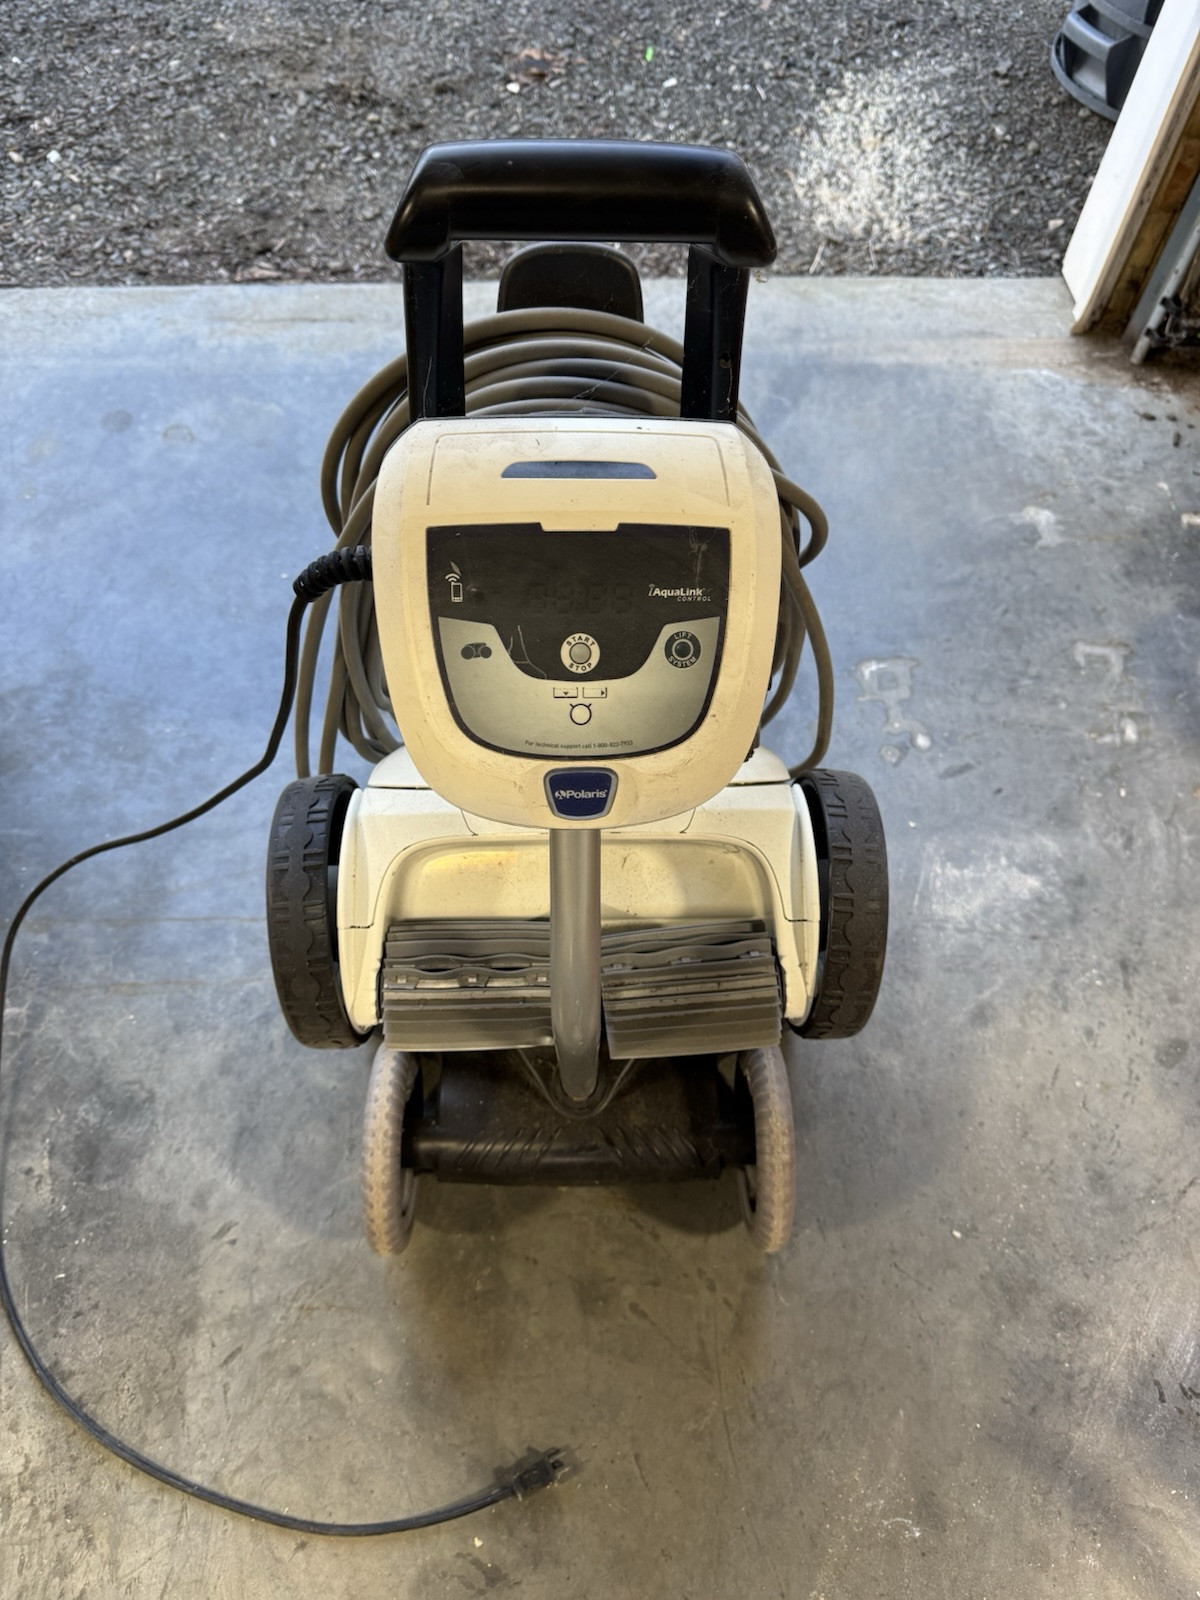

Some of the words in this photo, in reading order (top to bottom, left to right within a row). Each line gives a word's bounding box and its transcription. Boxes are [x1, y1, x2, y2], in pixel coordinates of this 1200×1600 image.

[673, 631, 693, 640] LIFT
[566, 635, 596, 647] START
[668, 655, 697, 668] SYSTEM
[568, 662, 593, 672] STOP
[566, 789, 607, 799] Polaris
